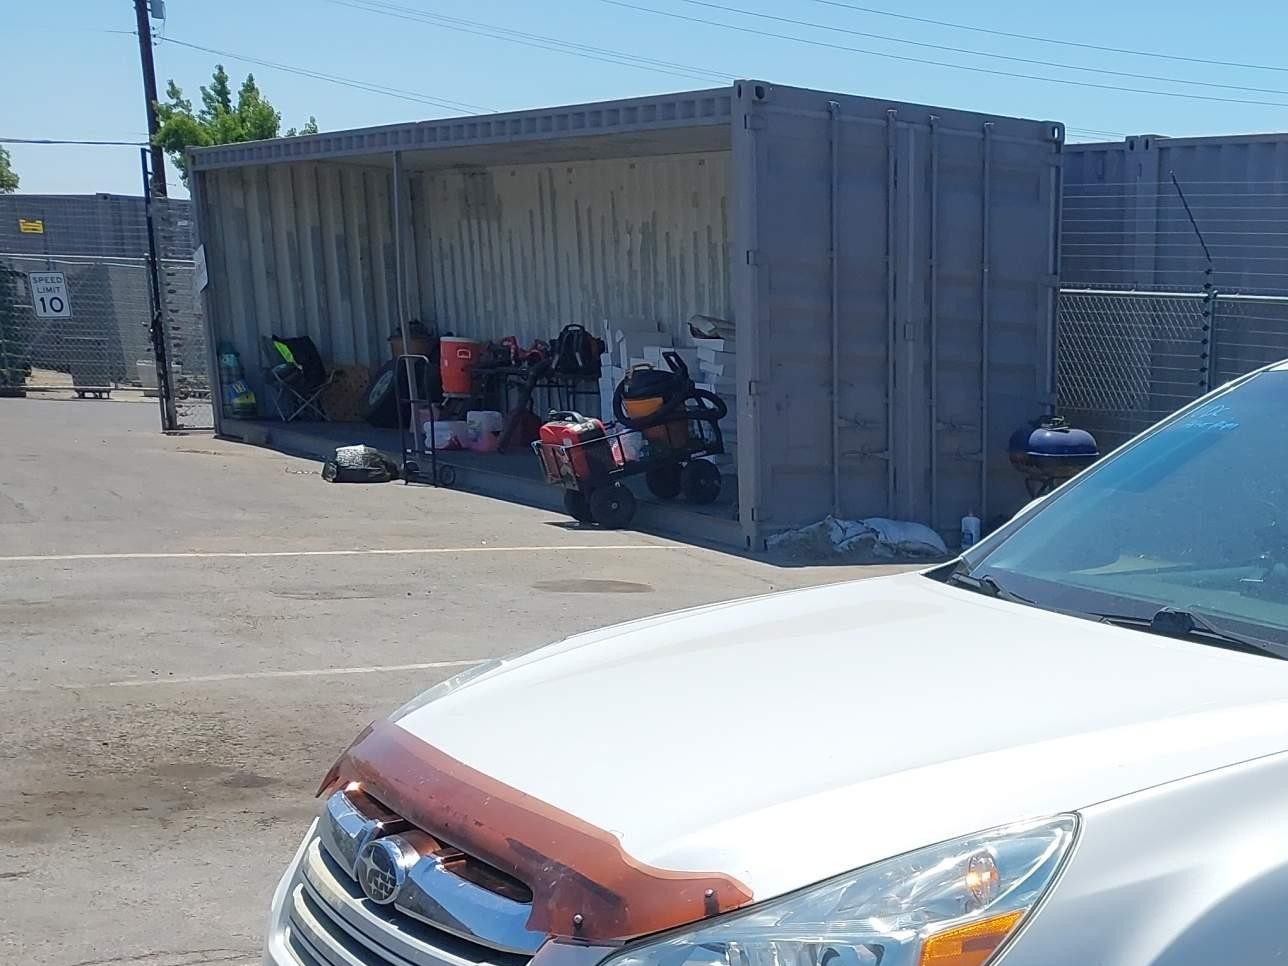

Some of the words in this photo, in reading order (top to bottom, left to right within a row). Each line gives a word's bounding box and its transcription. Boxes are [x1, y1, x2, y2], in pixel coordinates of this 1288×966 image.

[32, 276, 62, 284] SPEED
[37, 286, 61, 294] LIMIT
[39, 296, 64, 313] 10
